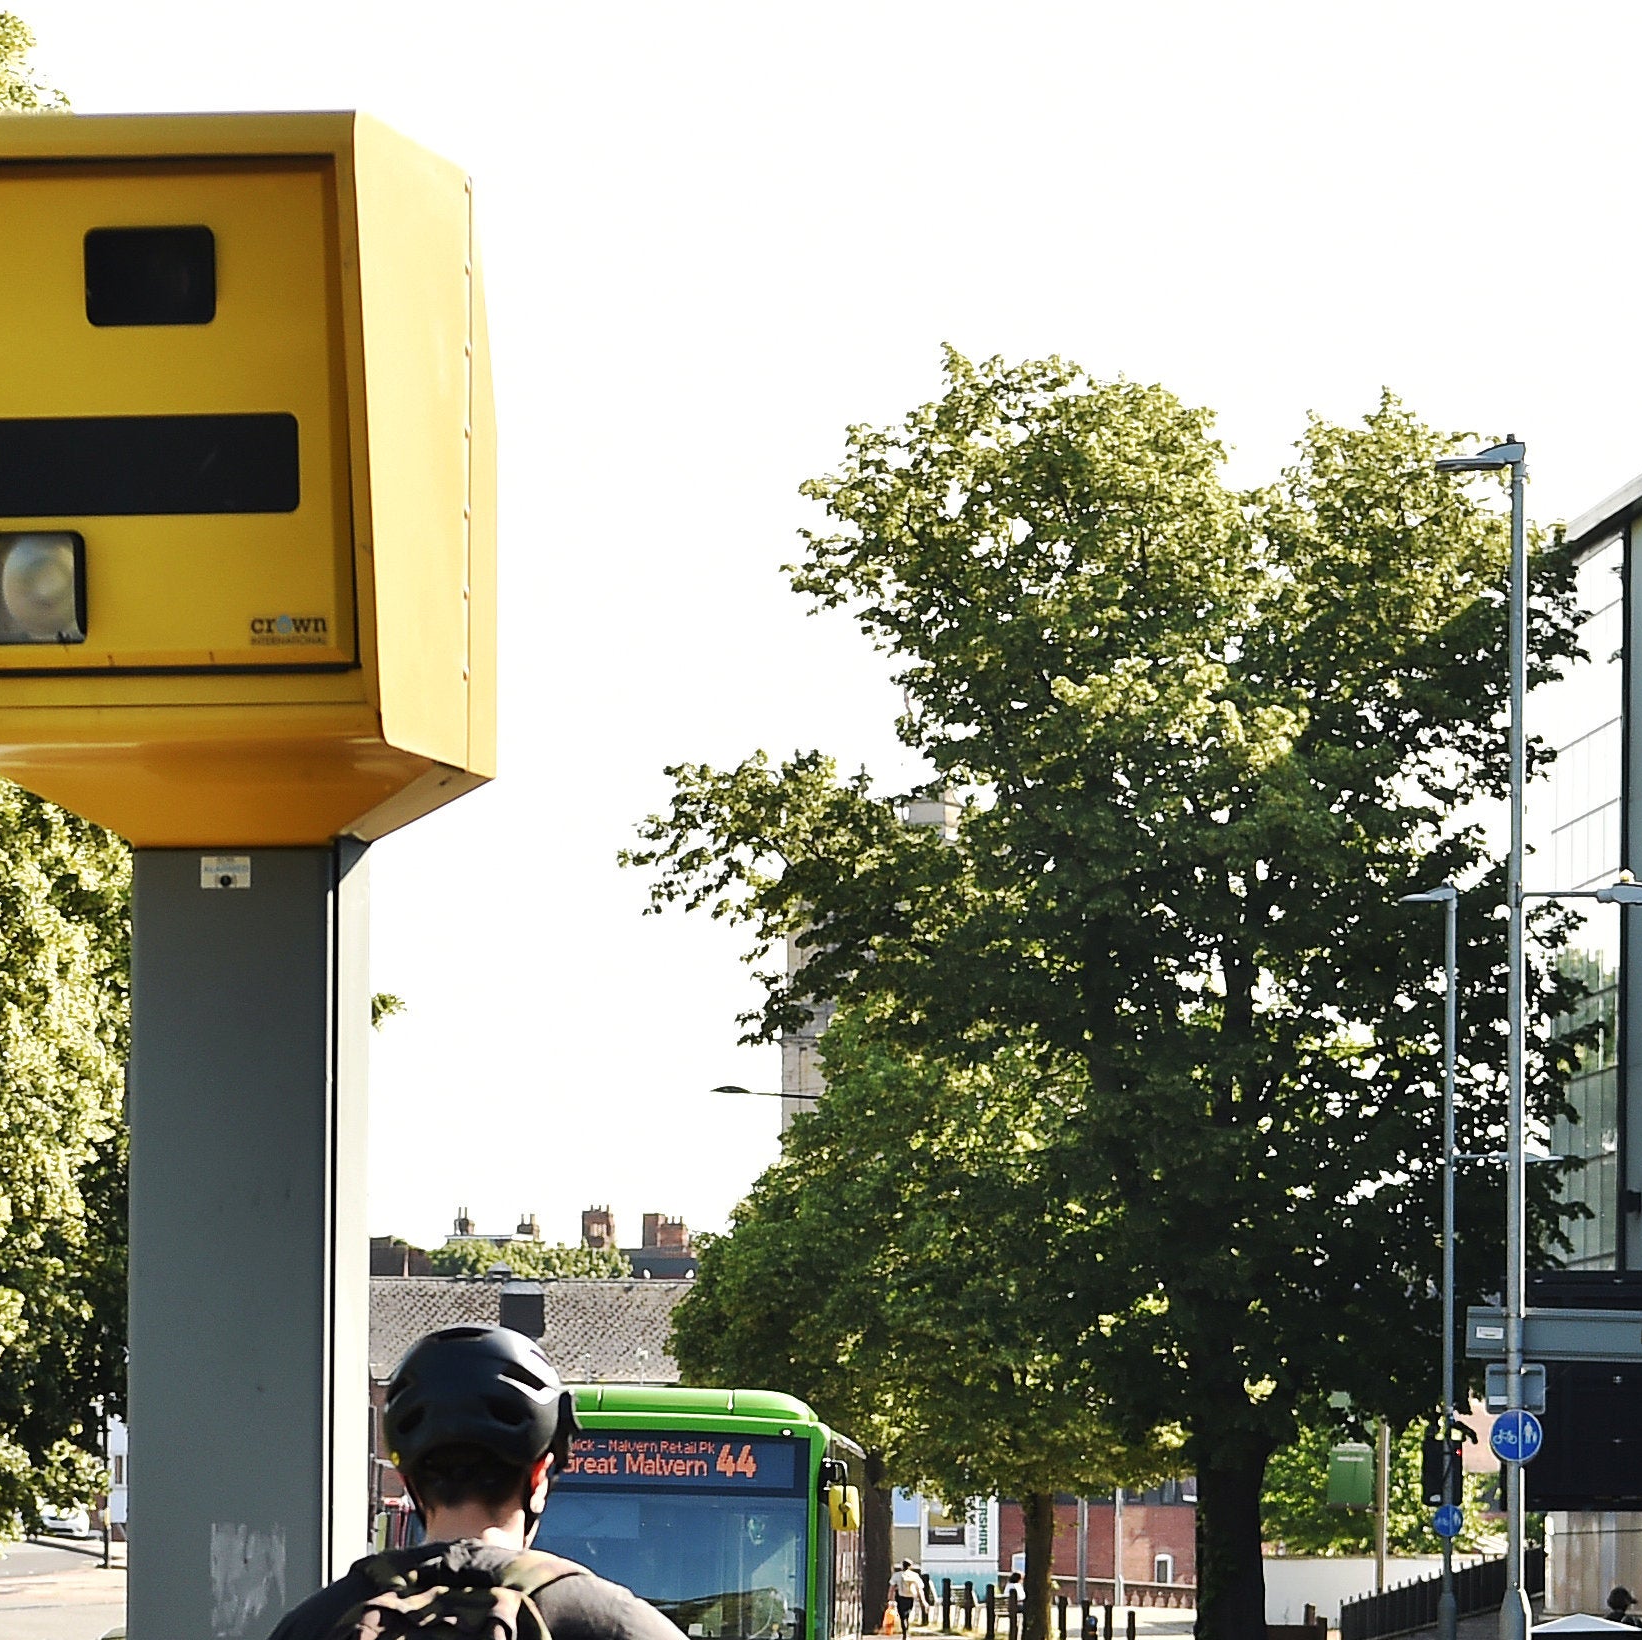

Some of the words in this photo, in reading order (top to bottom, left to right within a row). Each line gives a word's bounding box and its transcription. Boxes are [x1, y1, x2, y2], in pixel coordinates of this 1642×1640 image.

[608, 1439, 657, 1454] Malvern
[660, 1440, 697, 1455] Retail
[699, 1441, 715, 1455] Pk
[625, 1453, 708, 1477] Malvern
[716, 1443, 757, 1479] 44
[978, 1500, 988, 1555] ERSHIRE
